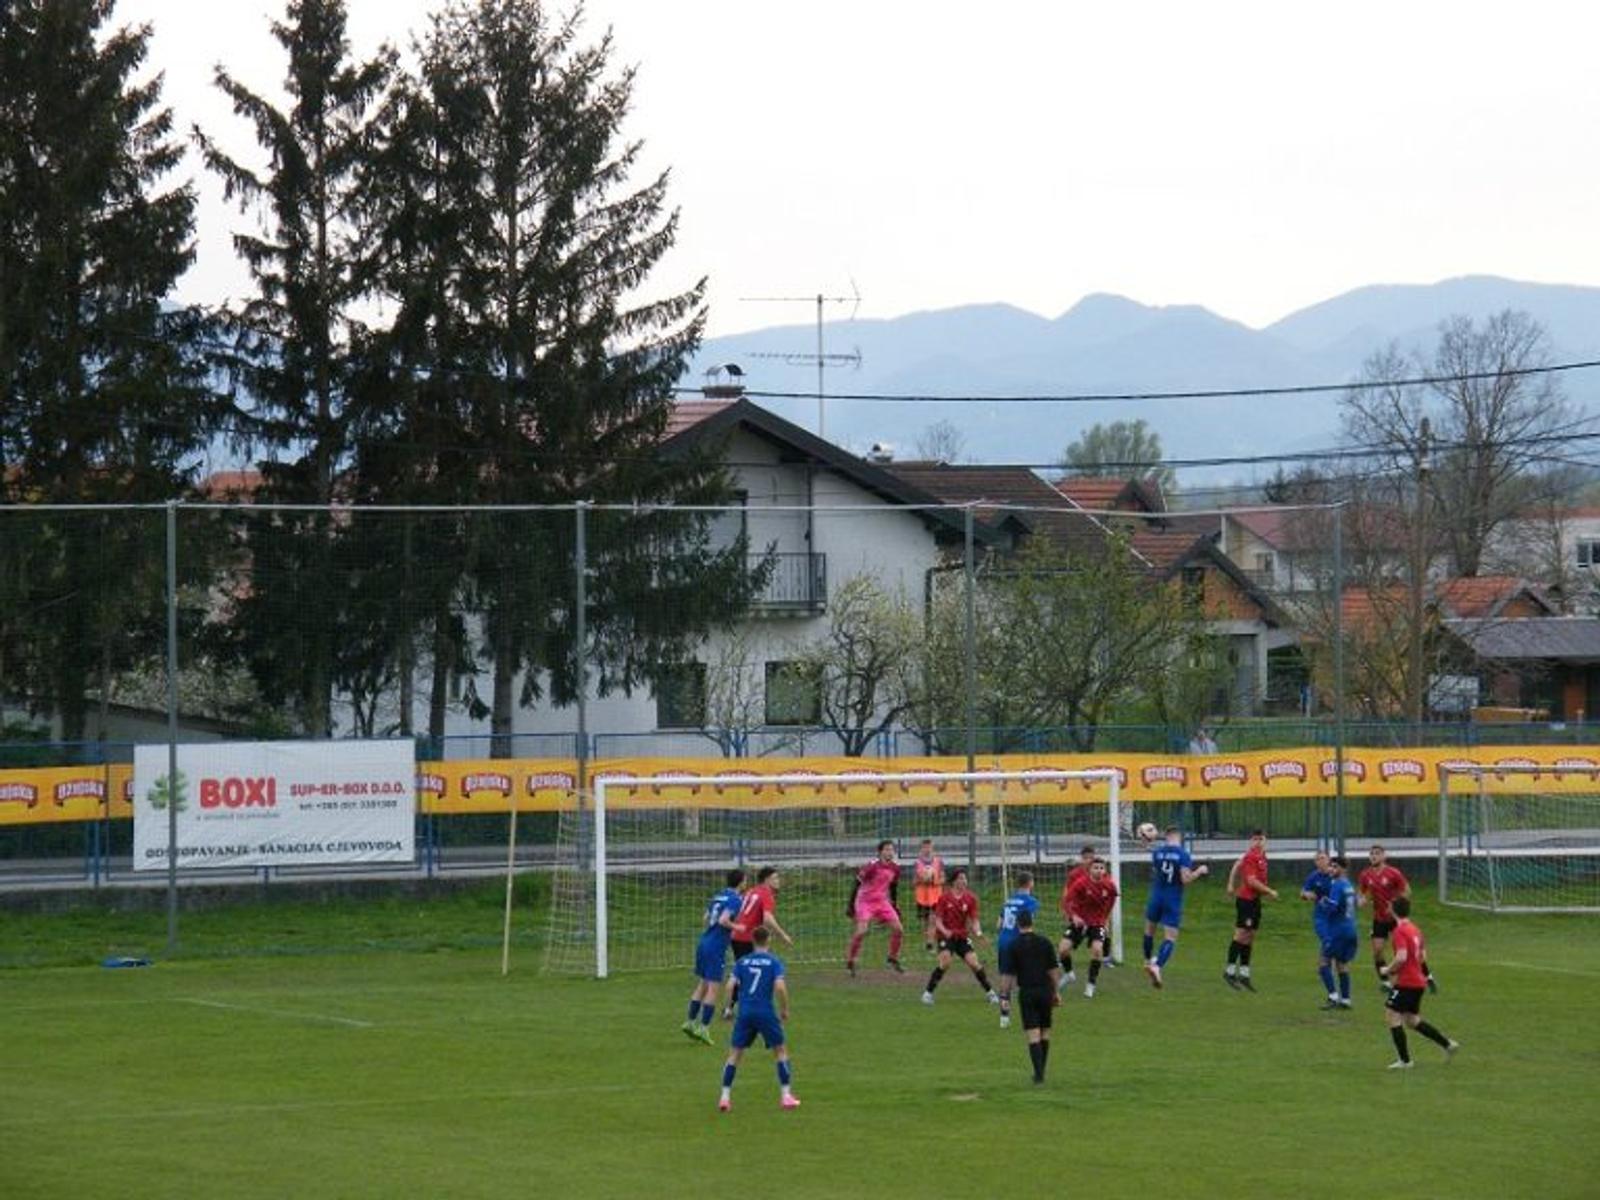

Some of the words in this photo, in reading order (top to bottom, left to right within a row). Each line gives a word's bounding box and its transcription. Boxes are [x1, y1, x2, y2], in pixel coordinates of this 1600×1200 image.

[199, 777, 276, 809] BOXI
[1161, 861, 1175, 884] 4
[748, 966, 762, 995] 7
